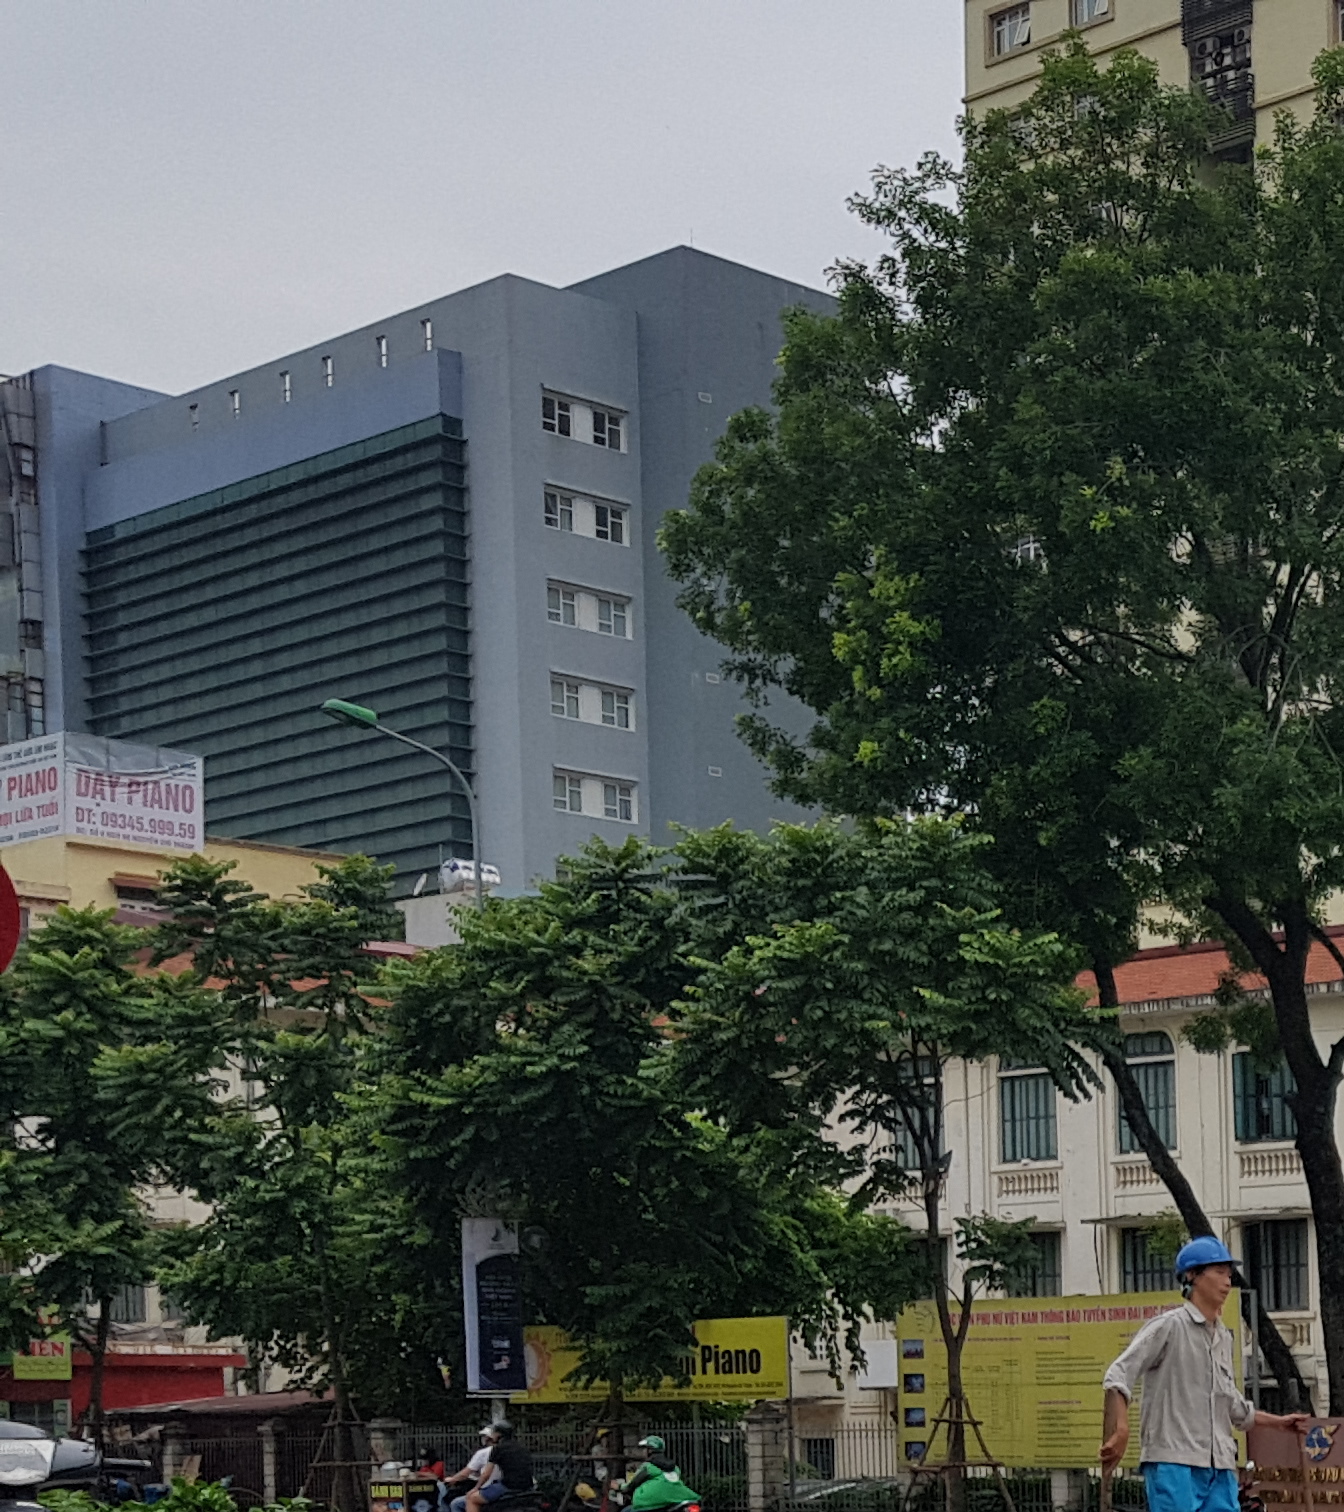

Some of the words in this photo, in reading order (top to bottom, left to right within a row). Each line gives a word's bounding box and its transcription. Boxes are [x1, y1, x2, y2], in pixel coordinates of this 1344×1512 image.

[7, 766, 57, 801] PIANO
[126, 778, 195, 814] PIANO
[101, 811, 196, 839] 09345.999.59
[701, 1344, 762, 1376] Piano
